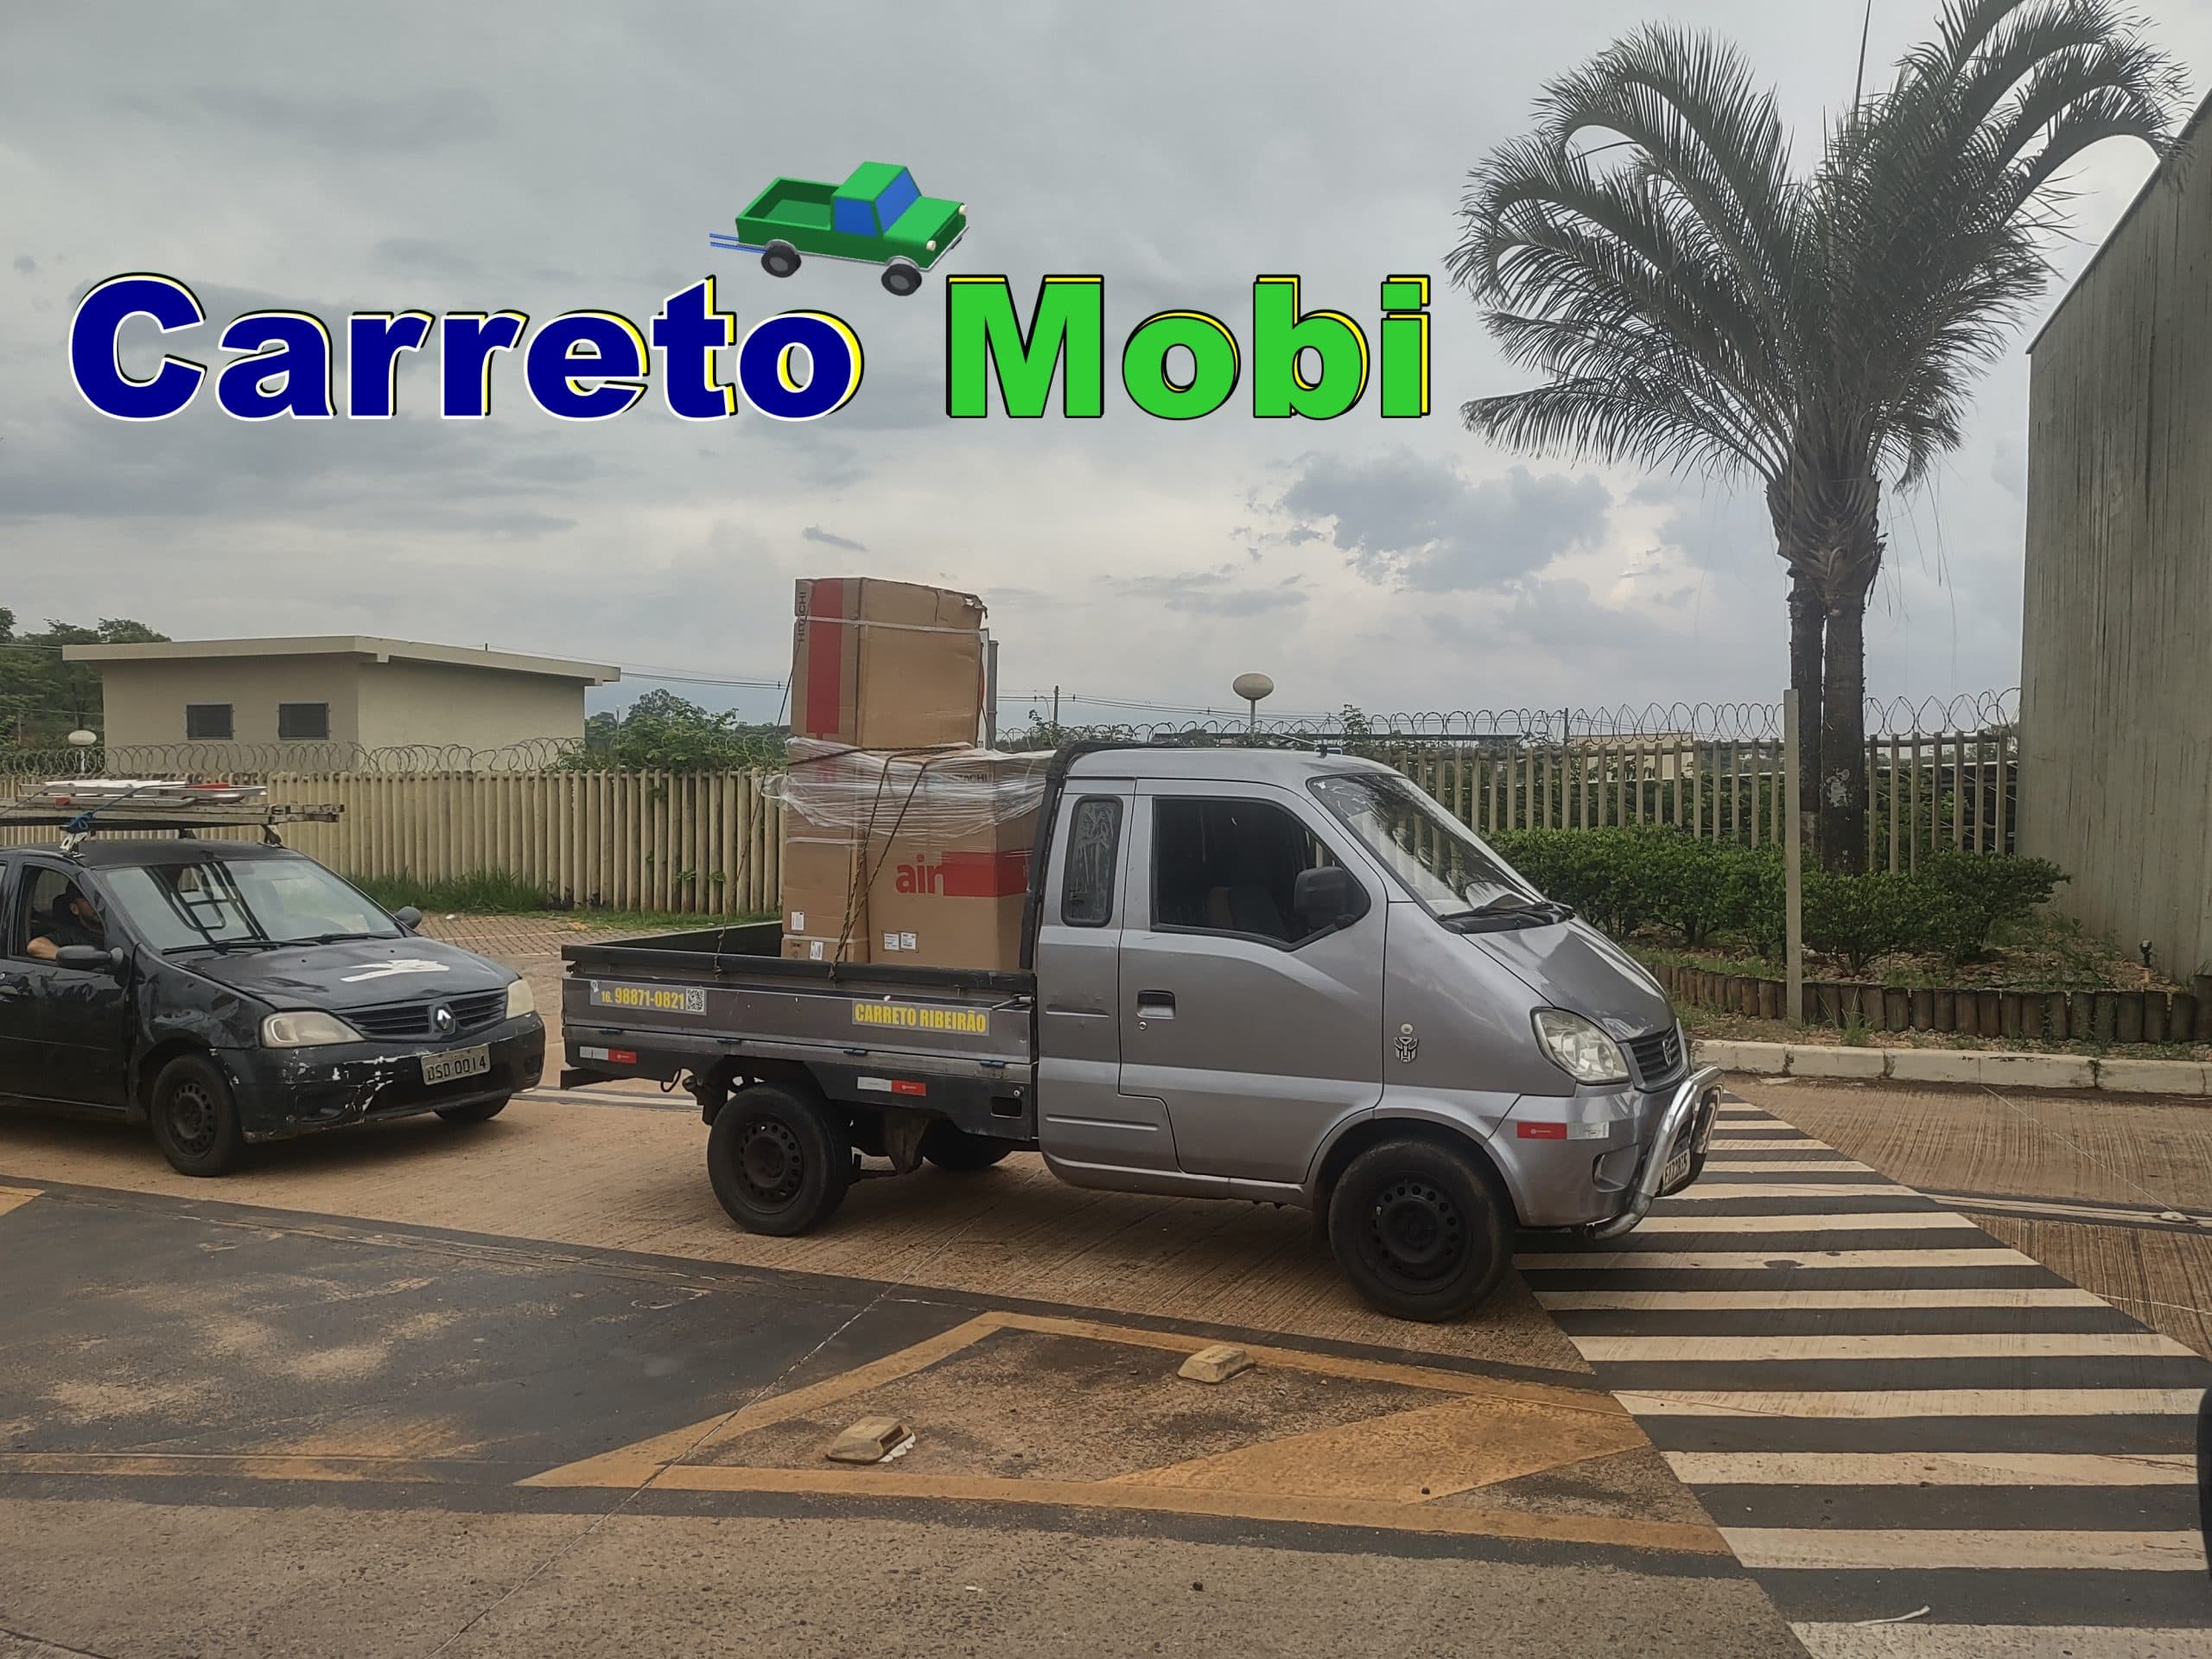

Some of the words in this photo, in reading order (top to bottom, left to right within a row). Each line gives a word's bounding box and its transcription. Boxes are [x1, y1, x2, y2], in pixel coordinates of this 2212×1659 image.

[615, 987, 684, 1010] 98871-0821
[855, 1003, 916, 1027] CARRETO
[919, 1008, 986, 1033] RIBEIRÃO
